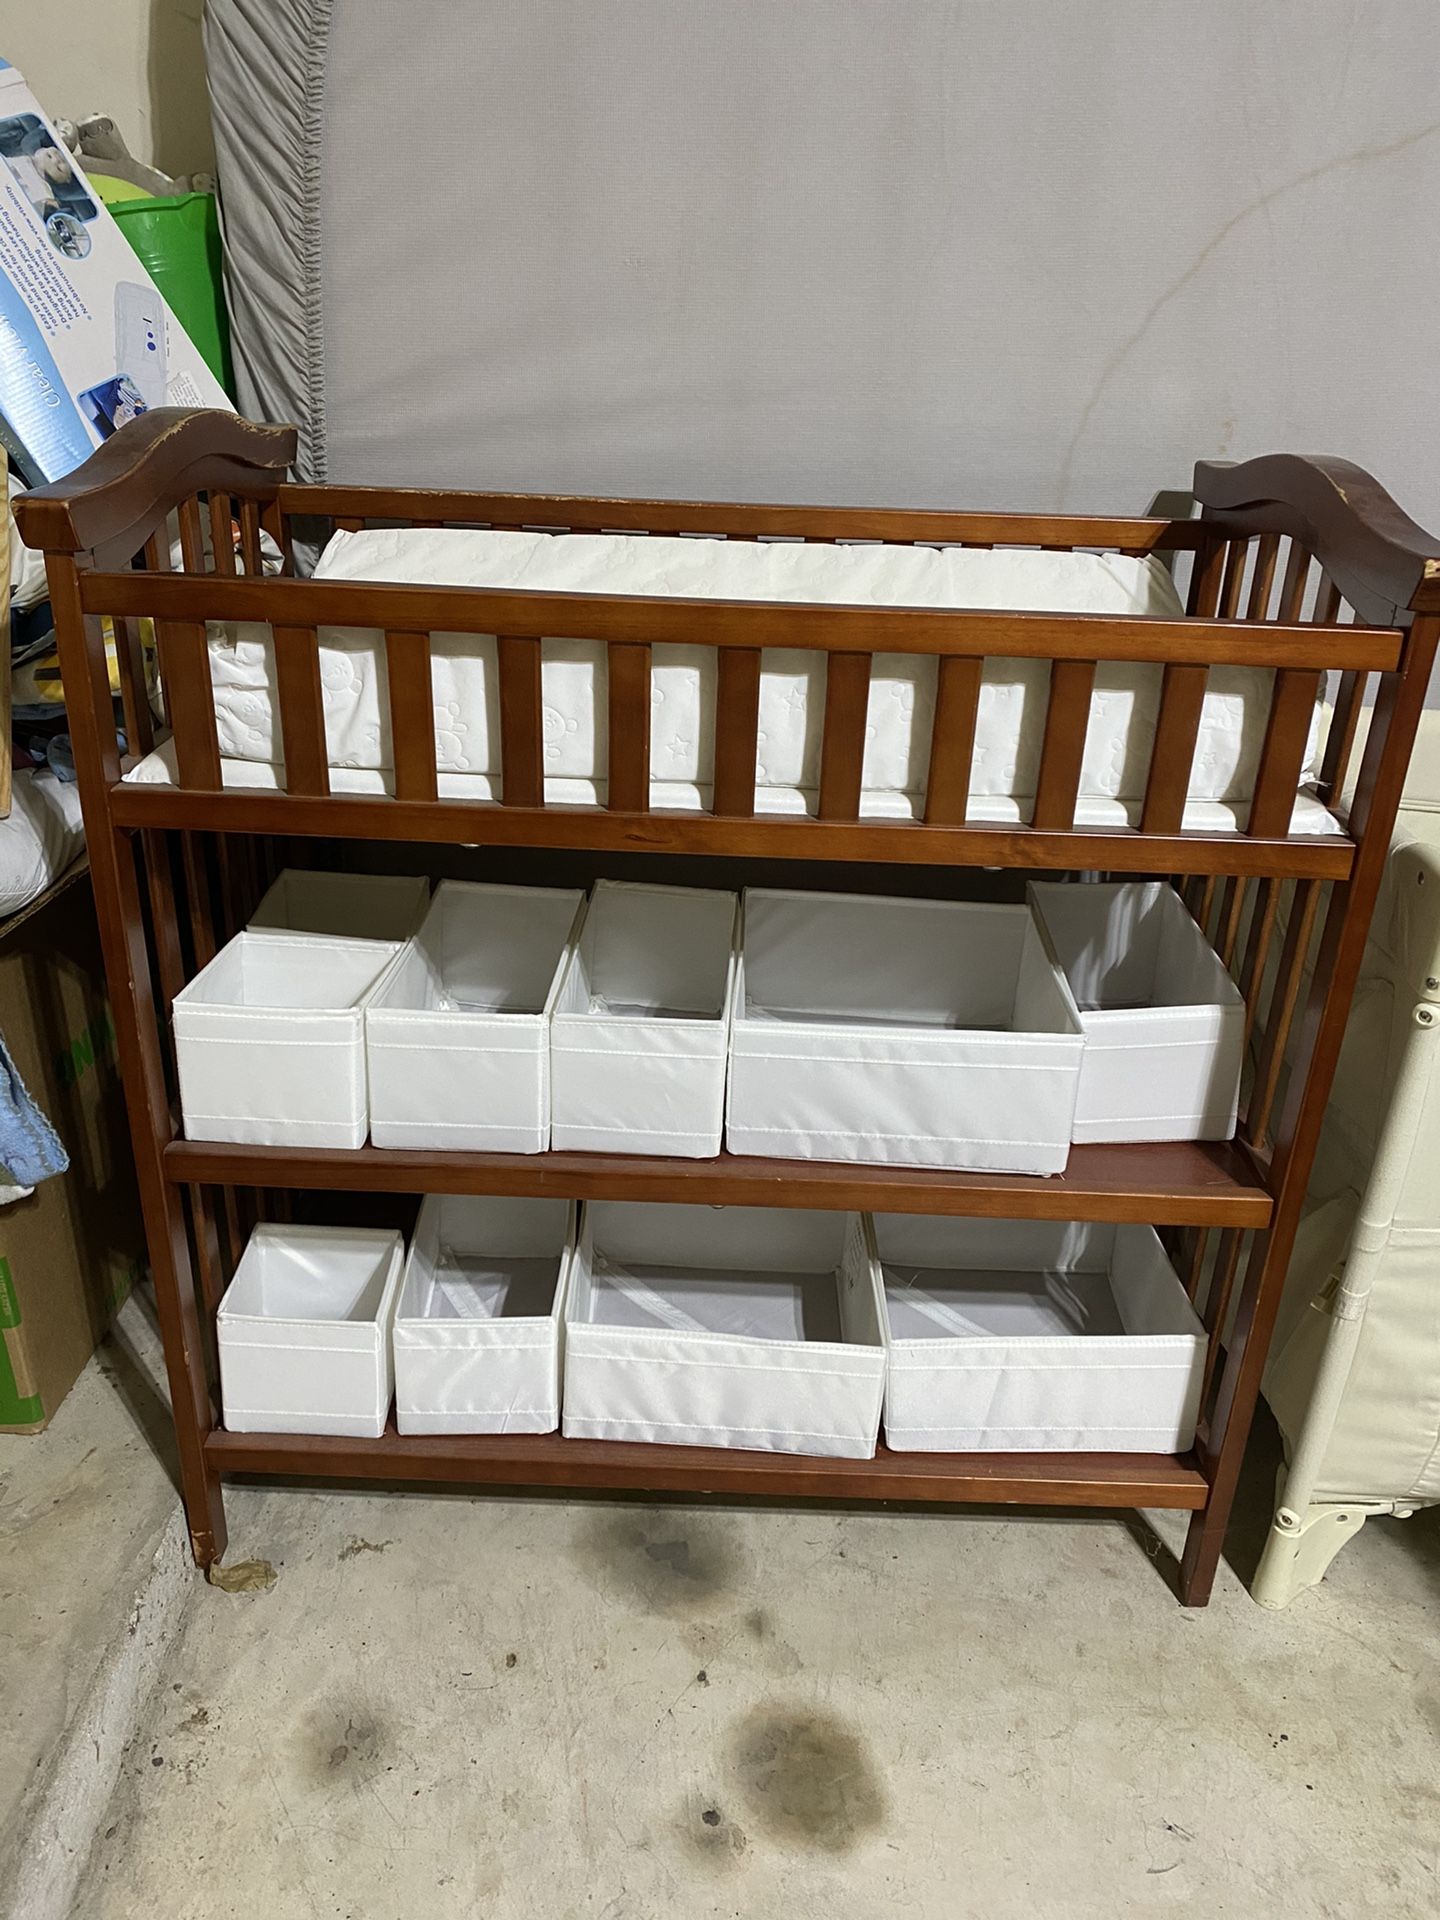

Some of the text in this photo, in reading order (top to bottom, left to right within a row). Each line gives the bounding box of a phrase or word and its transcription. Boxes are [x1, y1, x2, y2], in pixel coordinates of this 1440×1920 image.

[19, 248, 29, 263] you
[47, 252, 53, 260] to
[27, 263, 39, 279] help
[52, 261, 80, 302] obstruction
[32, 287, 41, 301] and
[34, 304, 40, 312] to
[44, 289, 67, 322] Designed
[39, 312, 51, 329] Easy
[27, 360, 61, 407] Clear
